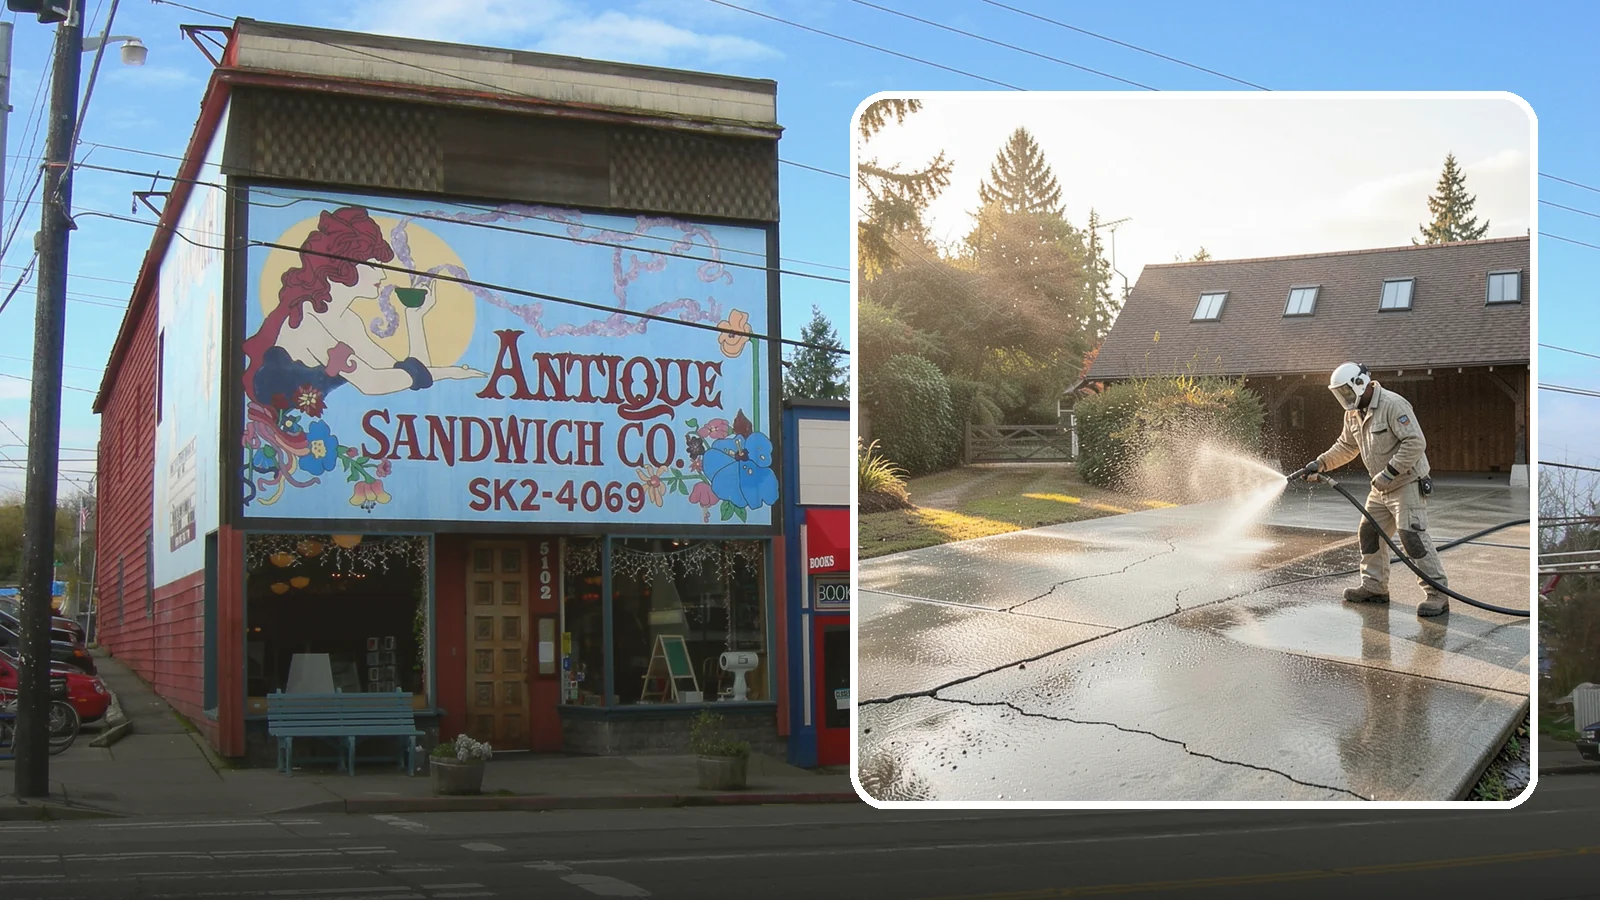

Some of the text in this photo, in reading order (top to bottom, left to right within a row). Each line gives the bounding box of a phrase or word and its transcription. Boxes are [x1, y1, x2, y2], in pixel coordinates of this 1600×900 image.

[475, 329, 724, 420] ANTIQUE
[361, 408, 685, 468] SANDWICH CO.
[468, 477, 646, 513] SK2-4069
[540, 541, 551, 600] 5102
[809, 555, 835, 569] BOOKS
